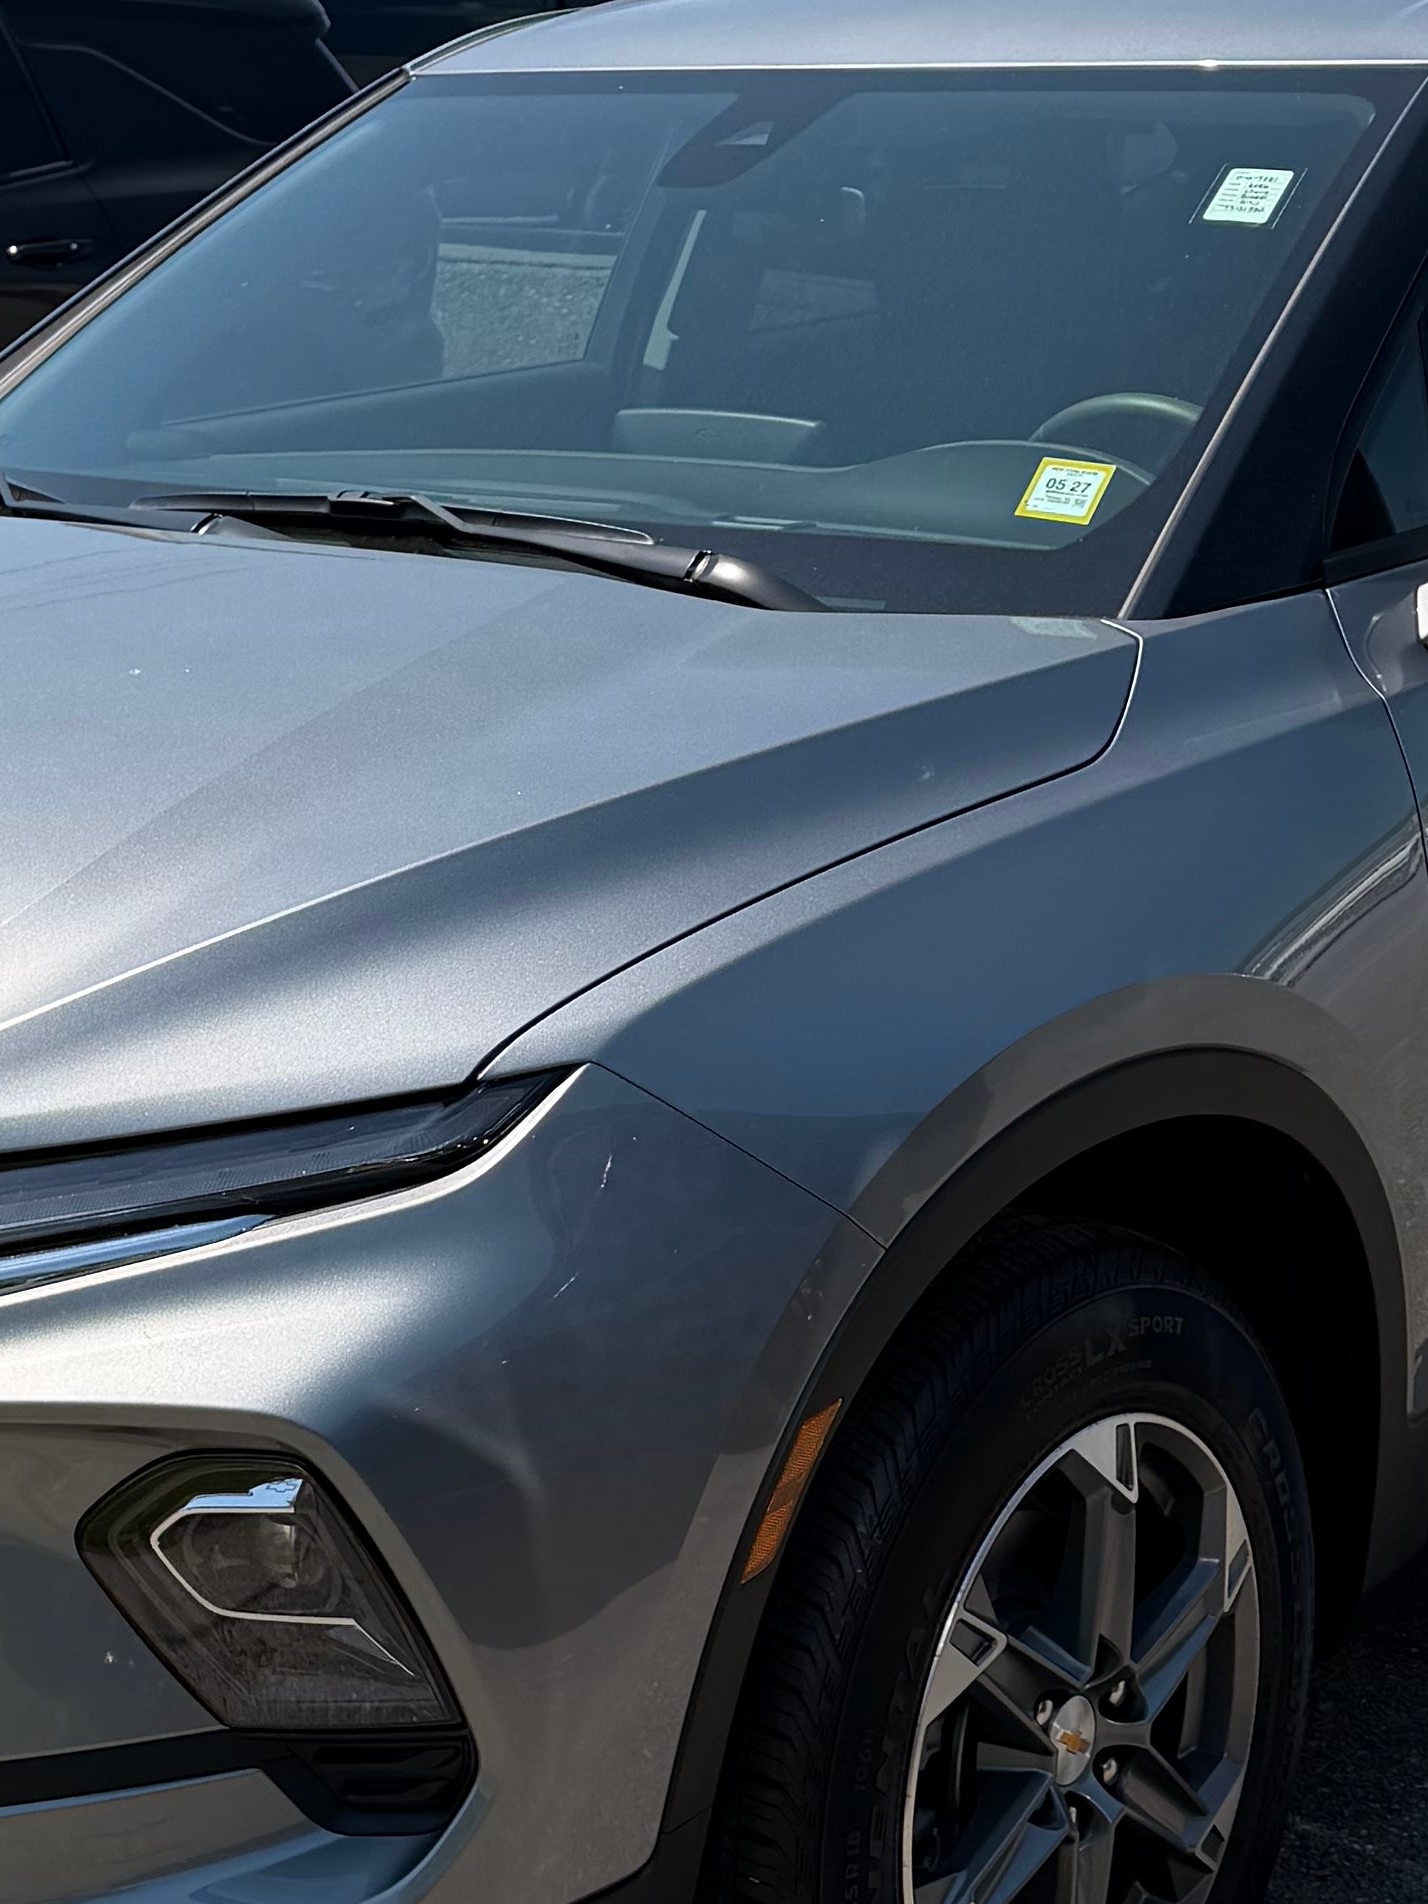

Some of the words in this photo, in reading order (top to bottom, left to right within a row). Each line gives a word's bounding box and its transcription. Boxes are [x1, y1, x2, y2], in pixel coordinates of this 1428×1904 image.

[1046, 477, 1068, 491] 05
[1069, 480, 1093, 493] 27
[1127, 1314, 1187, 1336] SPORT
